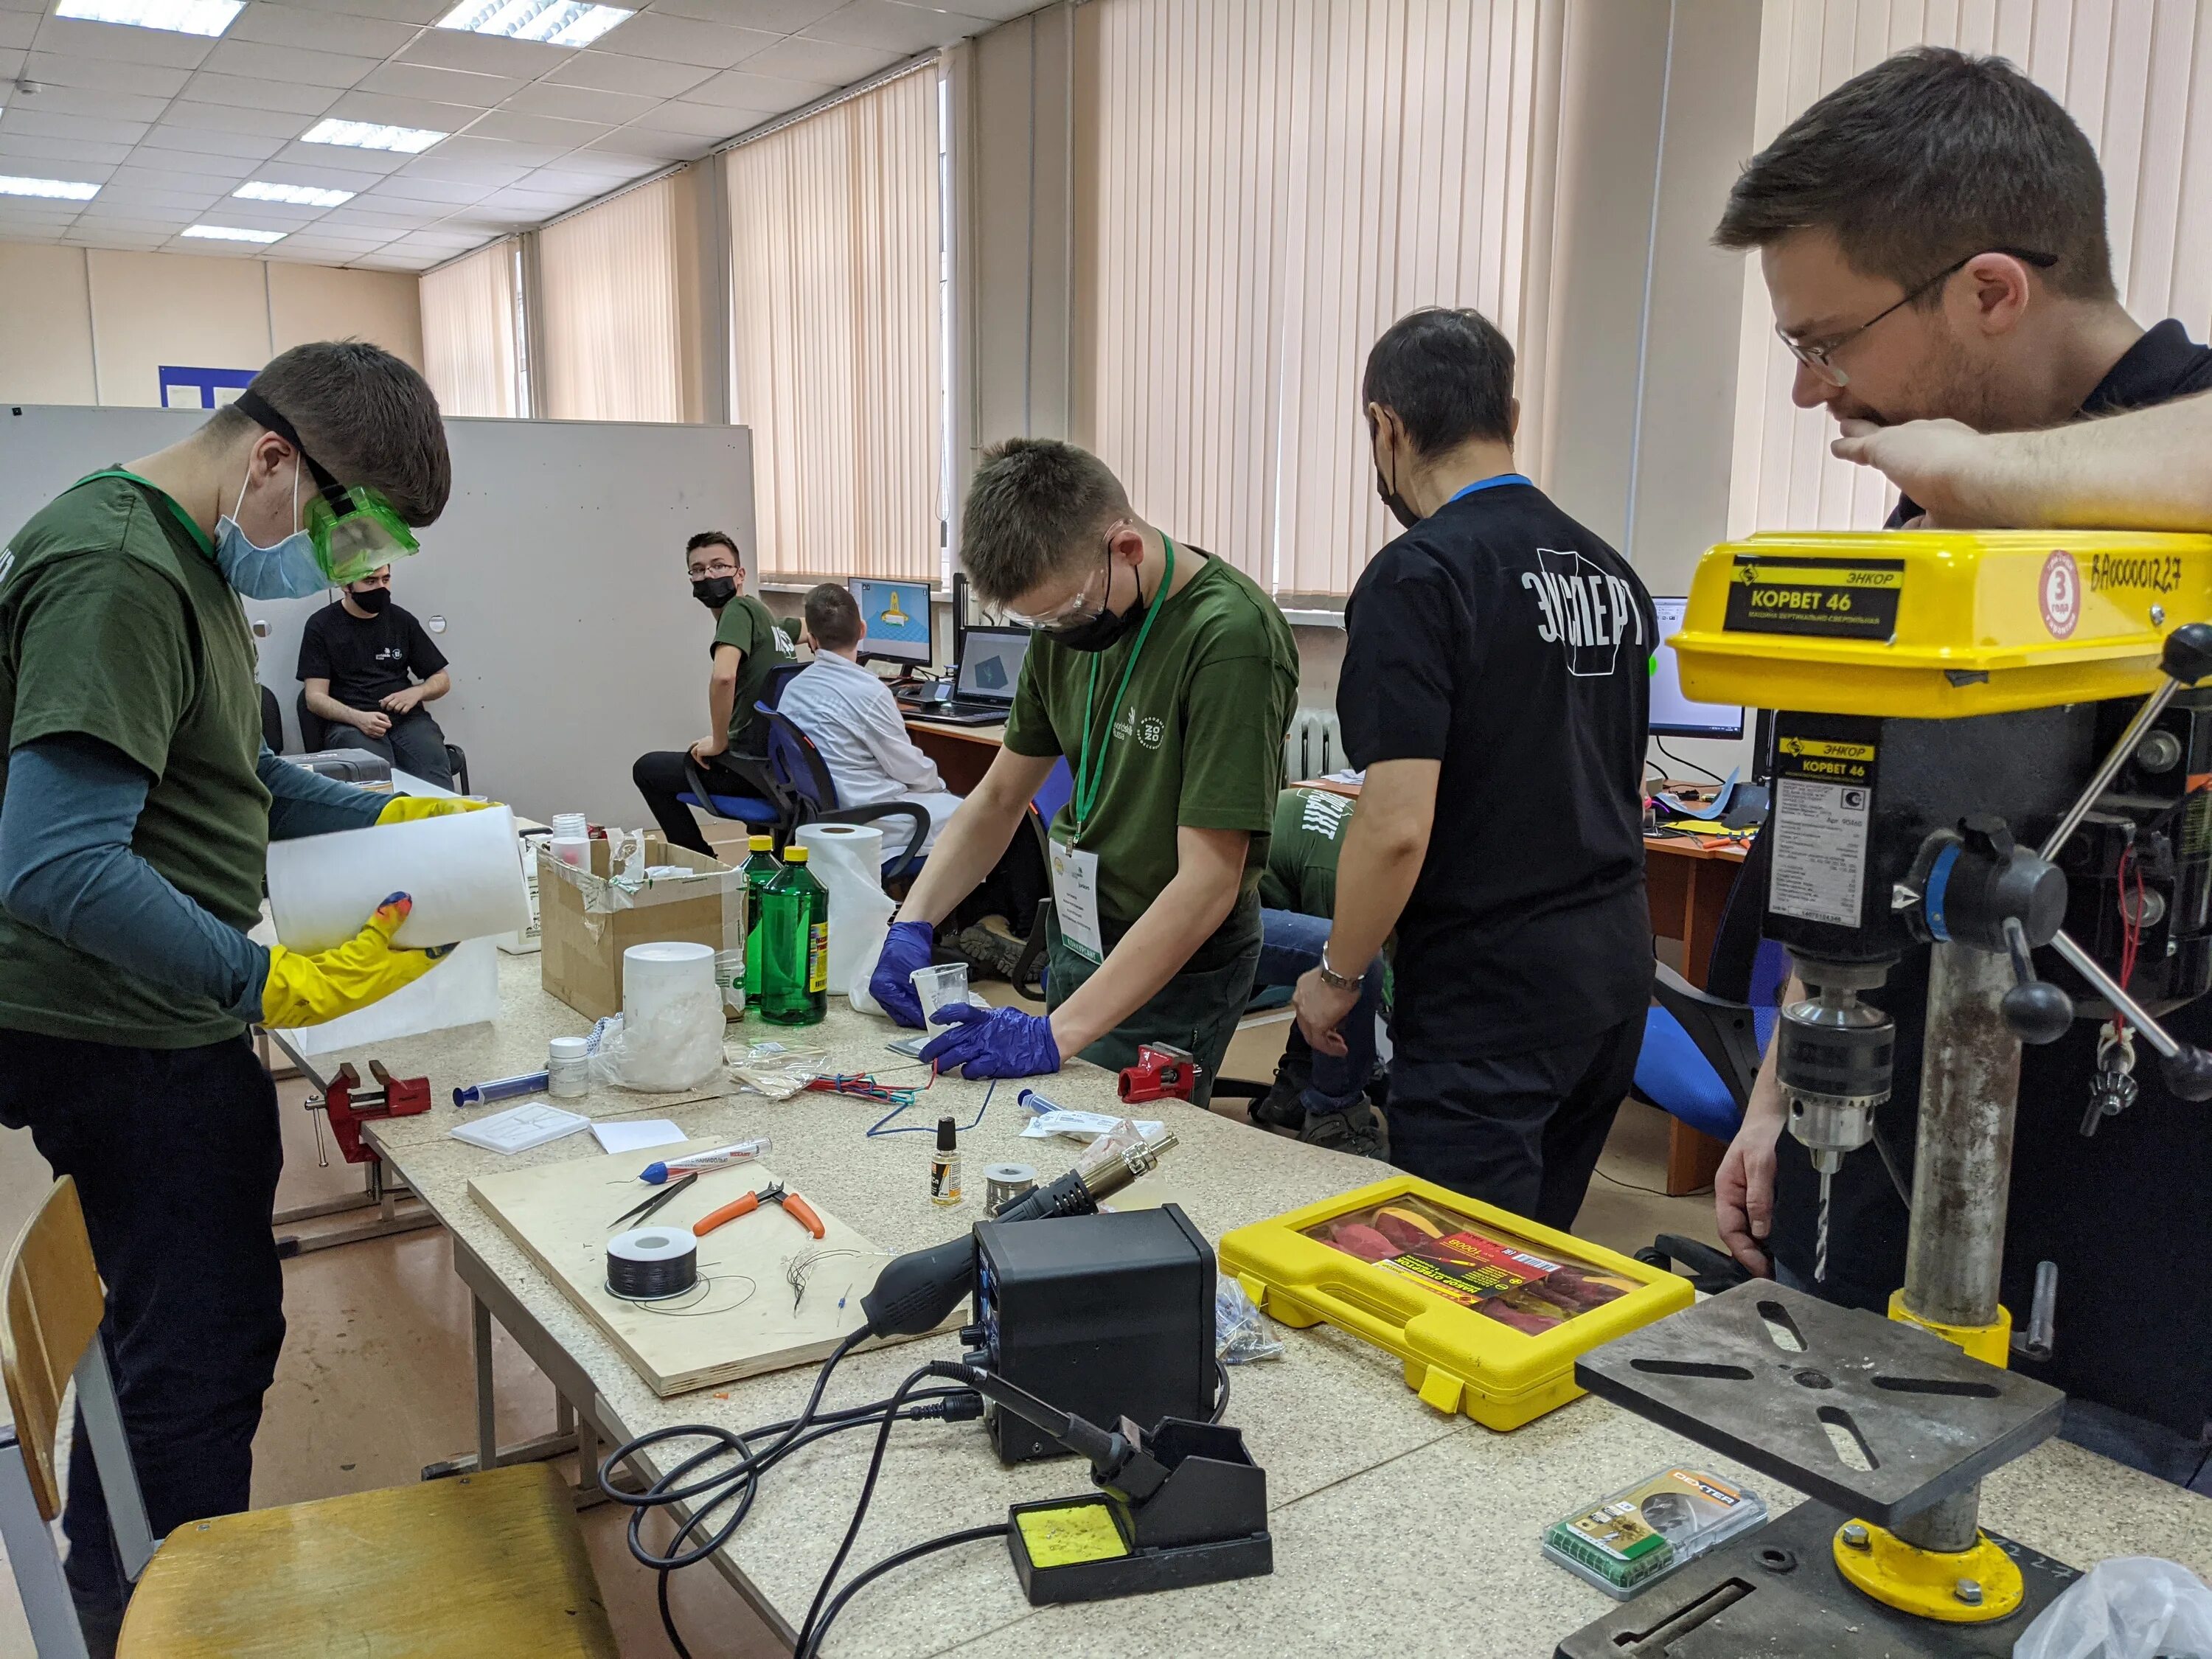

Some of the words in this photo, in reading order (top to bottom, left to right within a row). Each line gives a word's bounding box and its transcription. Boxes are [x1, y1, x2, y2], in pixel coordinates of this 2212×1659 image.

[1846, 572, 1894, 585] ЭНКОР
[2055, 570, 2066, 601] 3
[1751, 590, 1822, 610] КОРВЕТ
[1826, 593, 1852, 611] 46
[2051, 603, 2069, 614] года
[1823, 745, 1866, 757] ЭНКОР
[1803, 759, 1846, 775] КОРВЕТ
[1848, 764, 1865, 777] 46
[1394, 1258, 1444, 1281] ОТВЕРТОК
[1442, 1279, 1479, 1294] НАБОР
[1672, 1471, 1735, 1505] DEXTER
